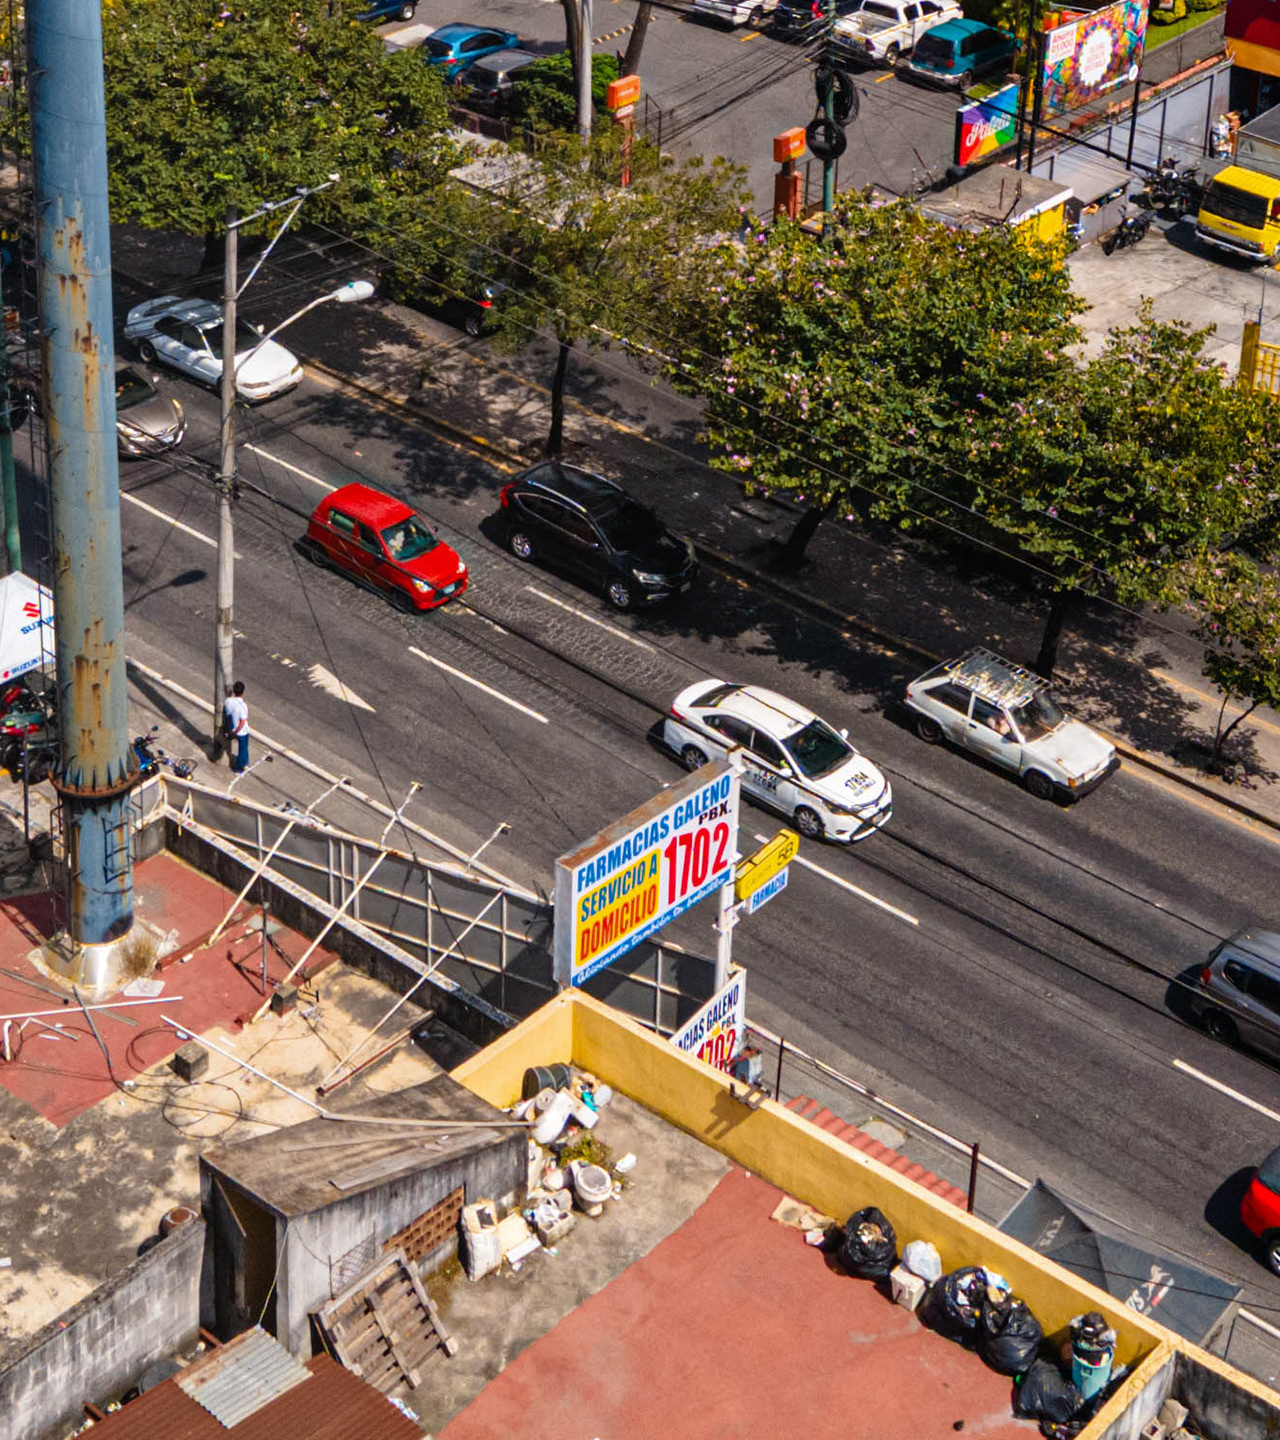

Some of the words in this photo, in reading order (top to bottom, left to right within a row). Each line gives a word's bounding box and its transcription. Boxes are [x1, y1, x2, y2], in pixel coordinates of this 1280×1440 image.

[20, 614, 55, 635] SUZUK
[11, 656, 43, 675] SUZUKI
[577, 814, 670, 893] FARMACIAS
[673, 774, 731, 830] GALENO
[698, 799, 733, 826] PBX.
[664, 821, 730, 906] 1702
[581, 859, 646, 922] SERVICIO
[648, 853, 658, 878] A
[751, 872, 787, 910] FARMACIA
[580, 883, 657, 961] DOMICILIO
[706, 984, 739, 1033] GALENO
[696, 1028, 737, 1071] 1702
